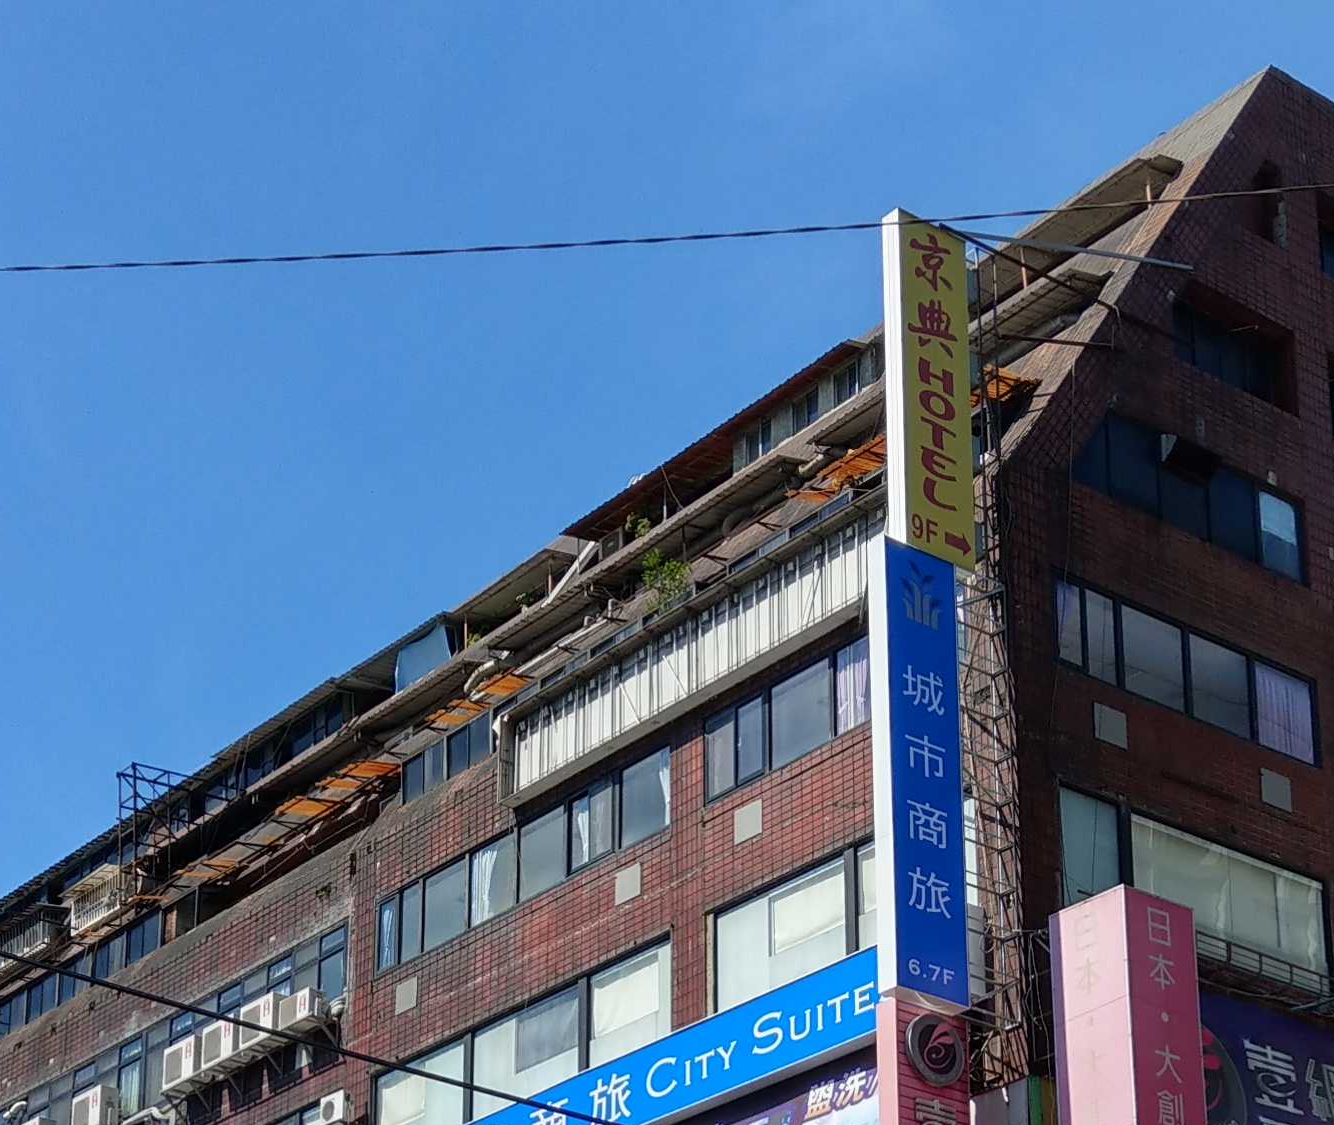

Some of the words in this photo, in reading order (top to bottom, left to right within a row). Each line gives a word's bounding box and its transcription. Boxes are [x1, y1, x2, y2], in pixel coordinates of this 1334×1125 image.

[911, 513, 938, 544] 9F
[902, 664, 952, 919] 城市商旅
[751, 979, 879, 1057] SUITE
